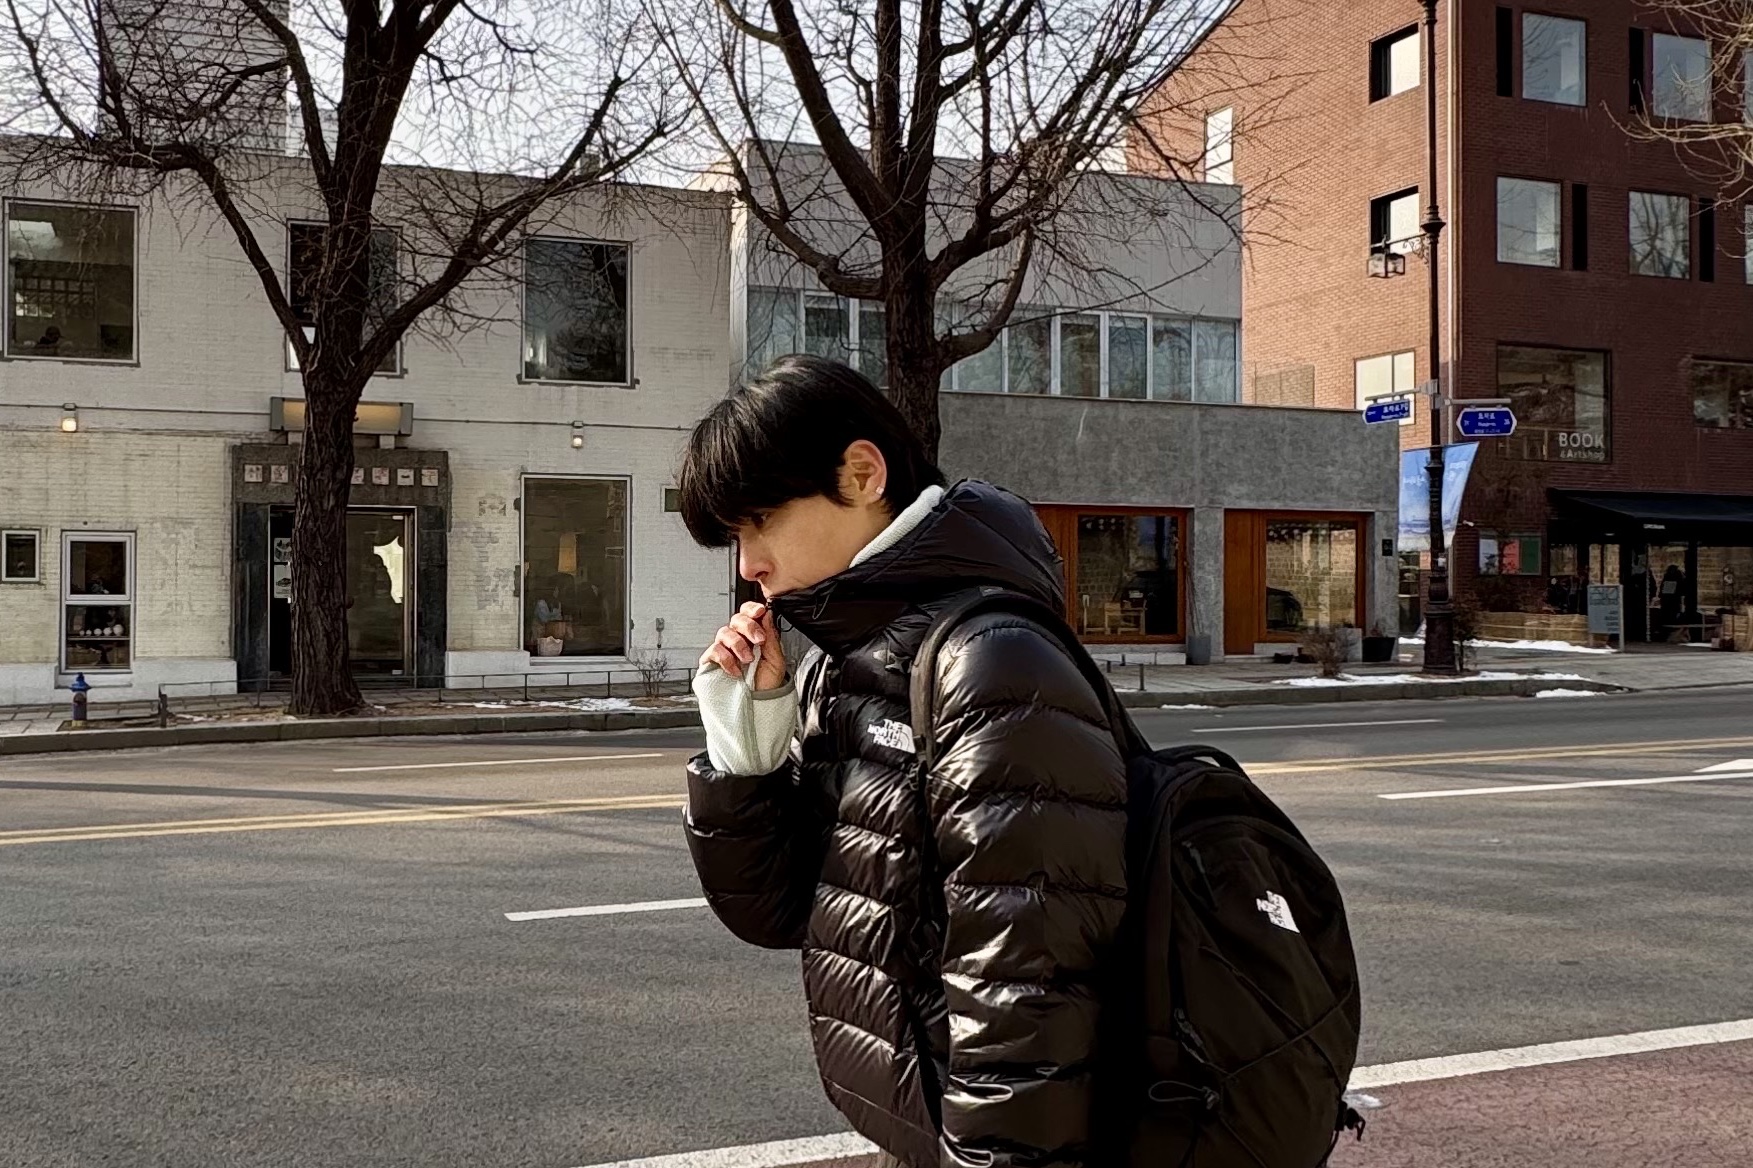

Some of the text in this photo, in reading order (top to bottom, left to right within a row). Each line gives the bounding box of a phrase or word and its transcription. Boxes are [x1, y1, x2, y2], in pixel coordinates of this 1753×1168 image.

[1558, 433, 1604, 448] BOOK
[867, 724, 902, 741] NORTH
[884, 719, 903, 731] THE
